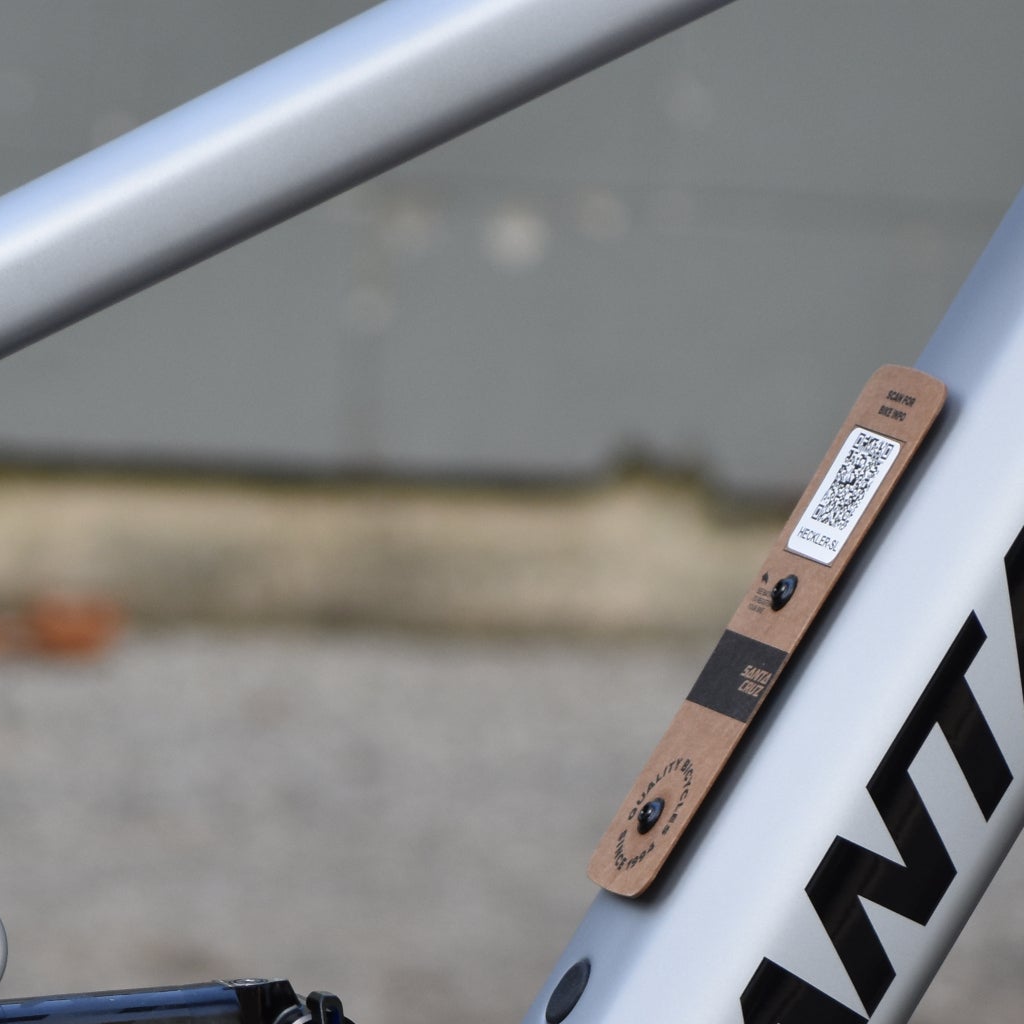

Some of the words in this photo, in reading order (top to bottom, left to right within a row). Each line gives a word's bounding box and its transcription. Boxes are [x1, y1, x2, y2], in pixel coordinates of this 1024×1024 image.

[797, 526, 839, 552] HECKLER-SL
[740, 664, 772, 685] SANTA
[738, 680, 765, 697] CRUZ
[628, 758, 683, 820] QUALITY
[661, 759, 694, 835] BICYCLES
[614, 829, 628, 870] SINCE
